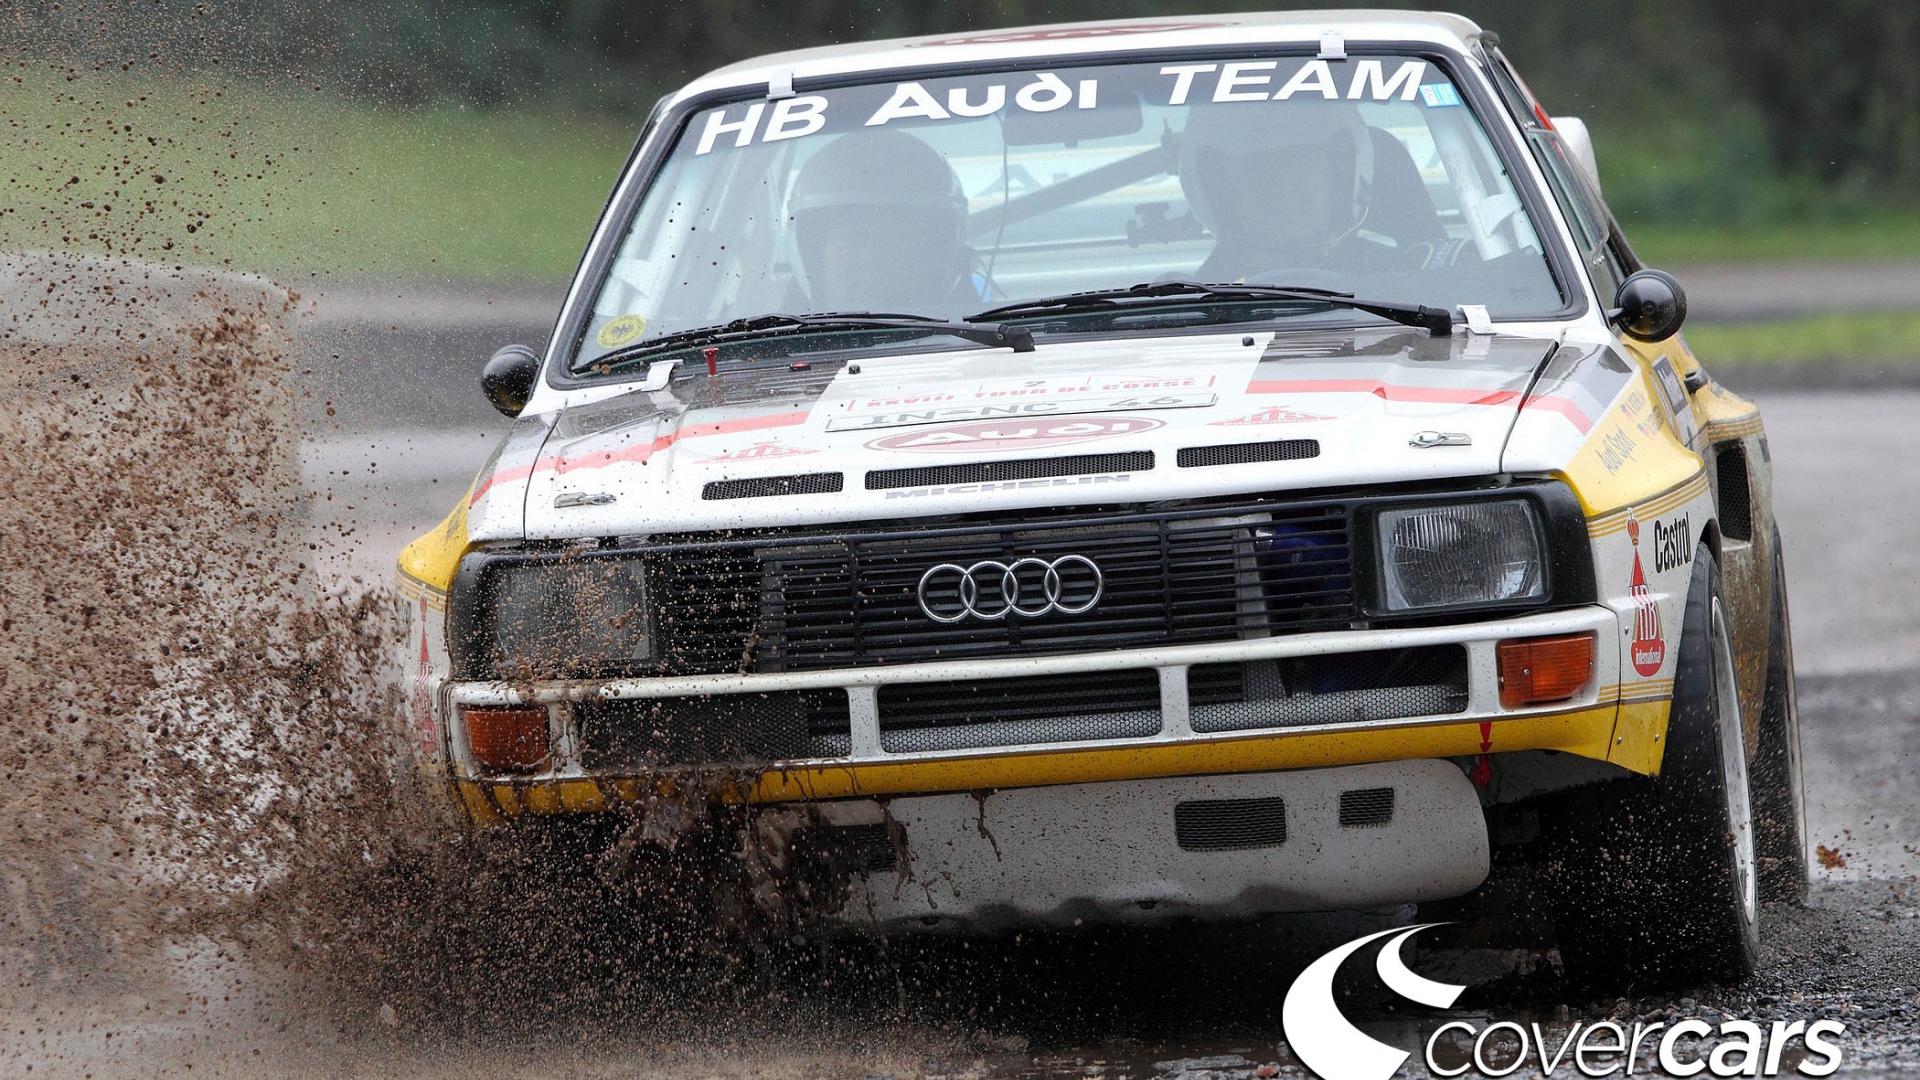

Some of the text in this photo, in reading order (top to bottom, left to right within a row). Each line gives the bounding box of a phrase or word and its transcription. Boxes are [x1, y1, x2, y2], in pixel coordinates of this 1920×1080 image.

[695, 60, 1427, 155] HB Audi TEAM
[975, 388, 1047, 398] TOUR
[1058, 385, 1092, 393] DE
[1103, 380, 1195, 390] CORSE
[1109, 396, 1183, 407] 46
[1595, 438, 1624, 475] Audi
[885, 474, 1130, 500] MICHELIN
[1654, 511, 1692, 574] Castrol
